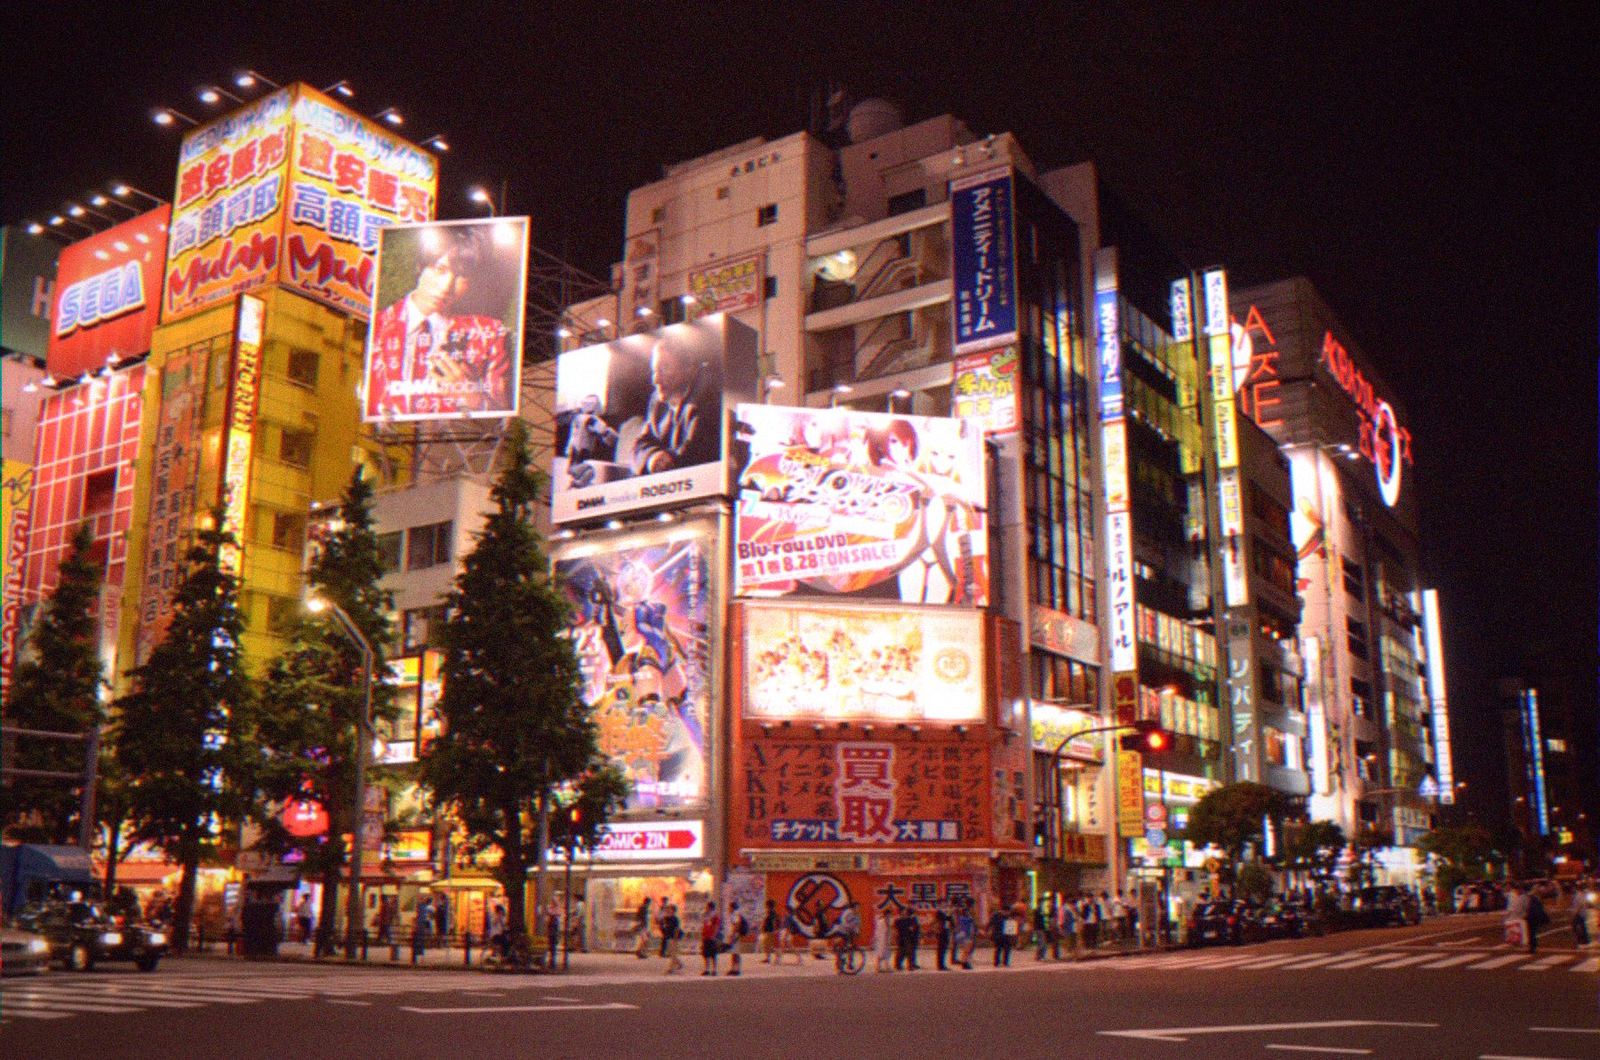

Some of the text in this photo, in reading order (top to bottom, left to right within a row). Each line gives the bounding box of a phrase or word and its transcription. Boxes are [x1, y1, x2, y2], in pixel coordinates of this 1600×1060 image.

[173, 178, 280, 258] 高額買取
[57, 261, 145, 334] SEGA
[168, 232, 278, 312] Mulan
[640, 479, 694, 499] ROBOTS
[792, 743, 813, 797] アニメ
[839, 744, 895, 840] 買取
[922, 746, 940, 798] ホビー
[645, 831, 669, 849] ZIN
[772, 821, 835, 840] チケット
